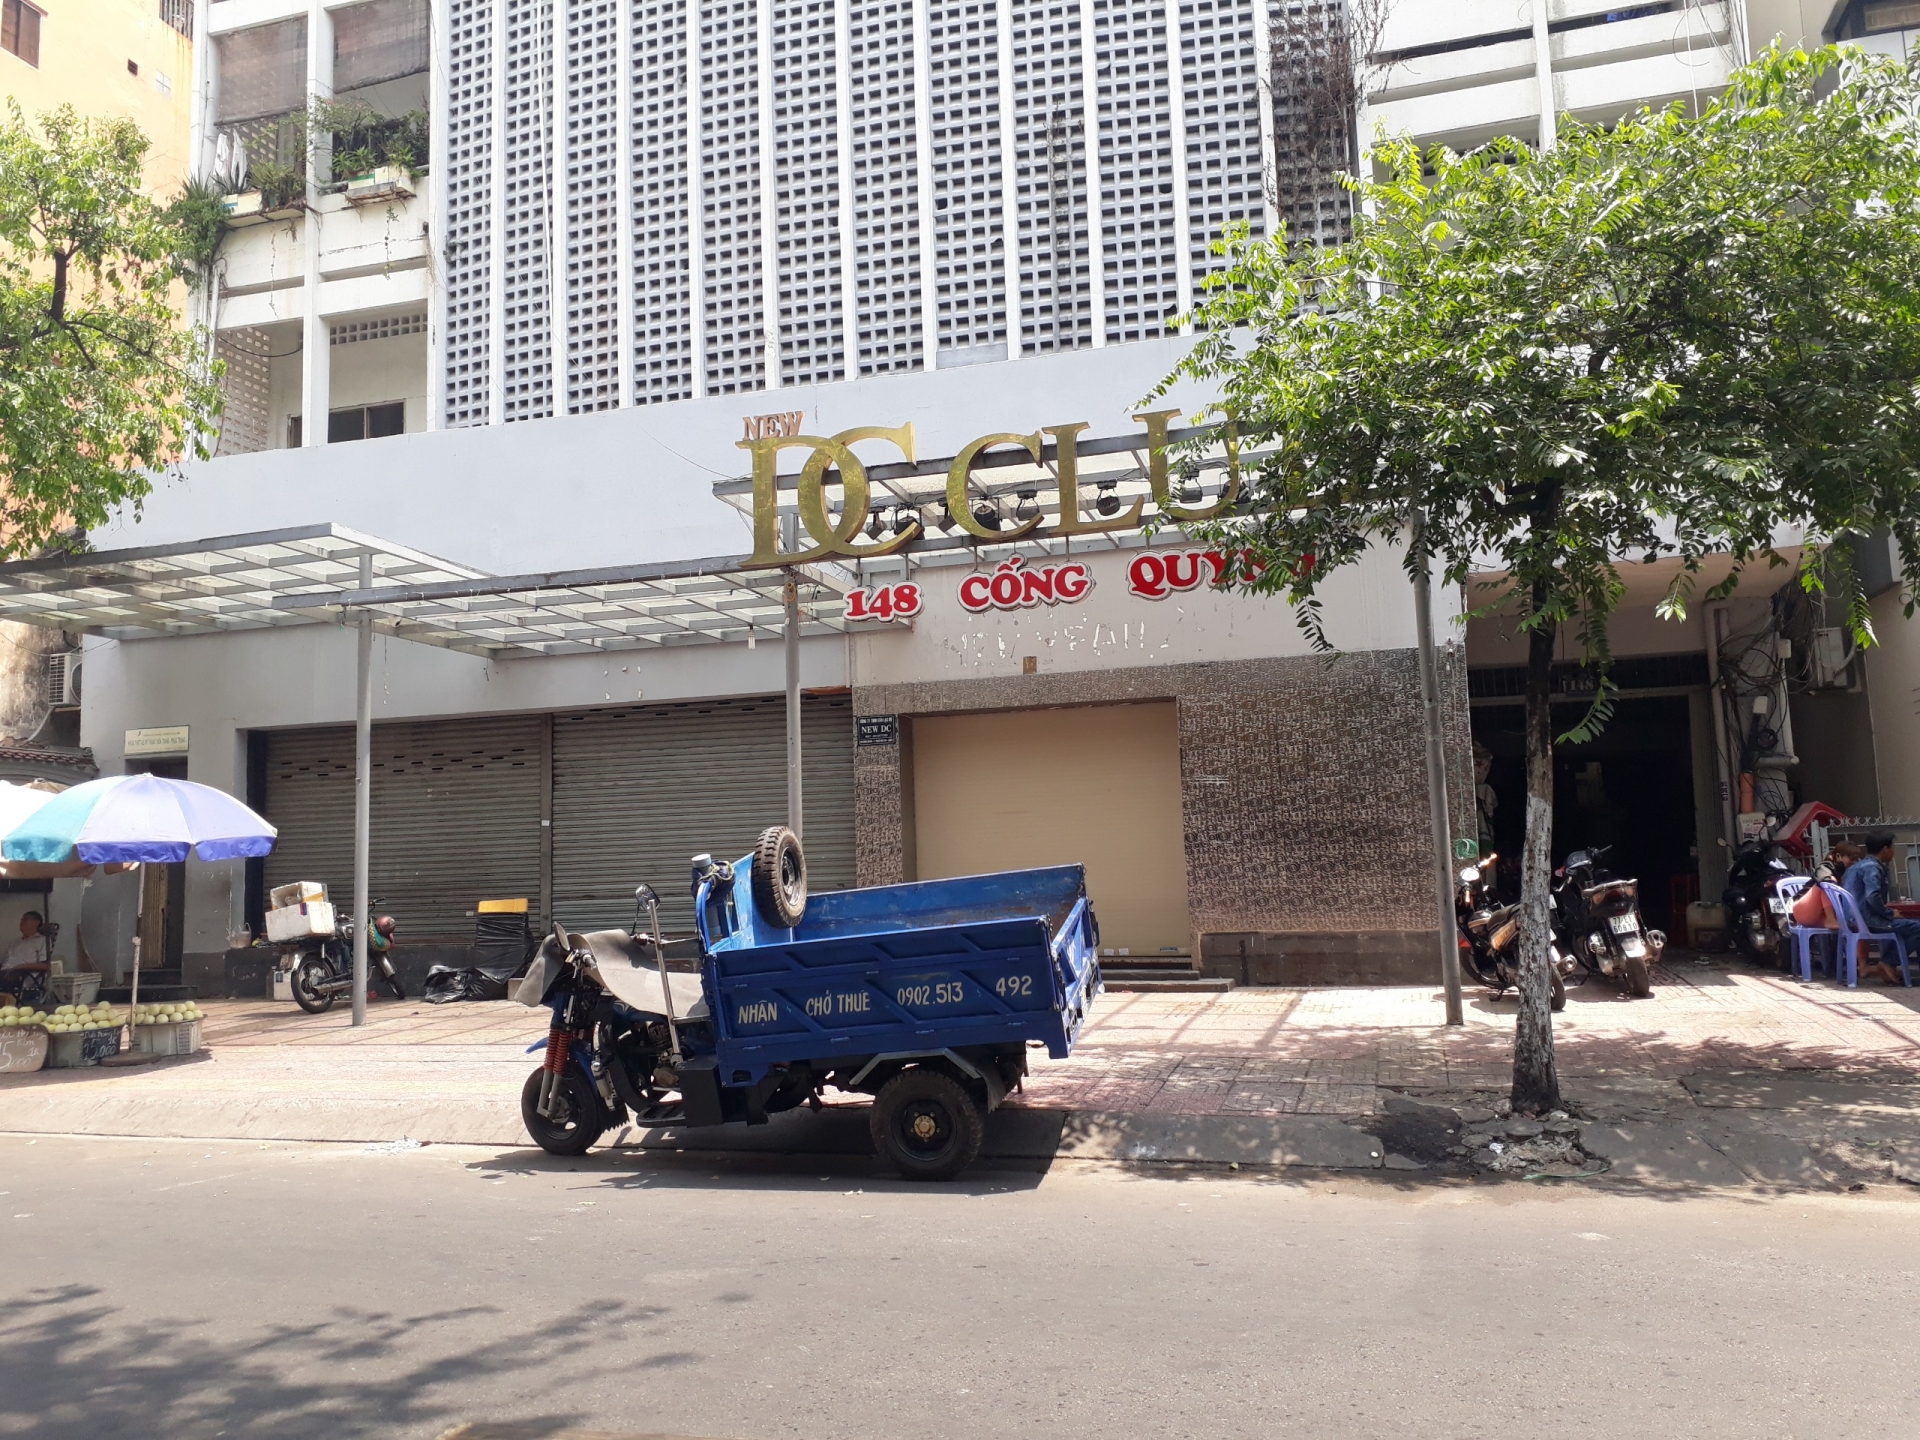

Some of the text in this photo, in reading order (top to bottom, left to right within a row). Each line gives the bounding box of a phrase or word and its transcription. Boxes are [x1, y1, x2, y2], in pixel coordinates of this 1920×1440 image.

[742, 410, 804, 441] NEW
[735, 421, 923, 568] DC
[845, 583, 920, 619] 148
[958, 552, 1090, 609] CỐNG
[861, 724, 892, 734] NEW DC
[738, 1000, 778, 1026] NHẬN
[805, 989, 832, 1016] CHỞ
[897, 981, 963, 1007] 0902.513
[995, 975, 1032, 997] 492
